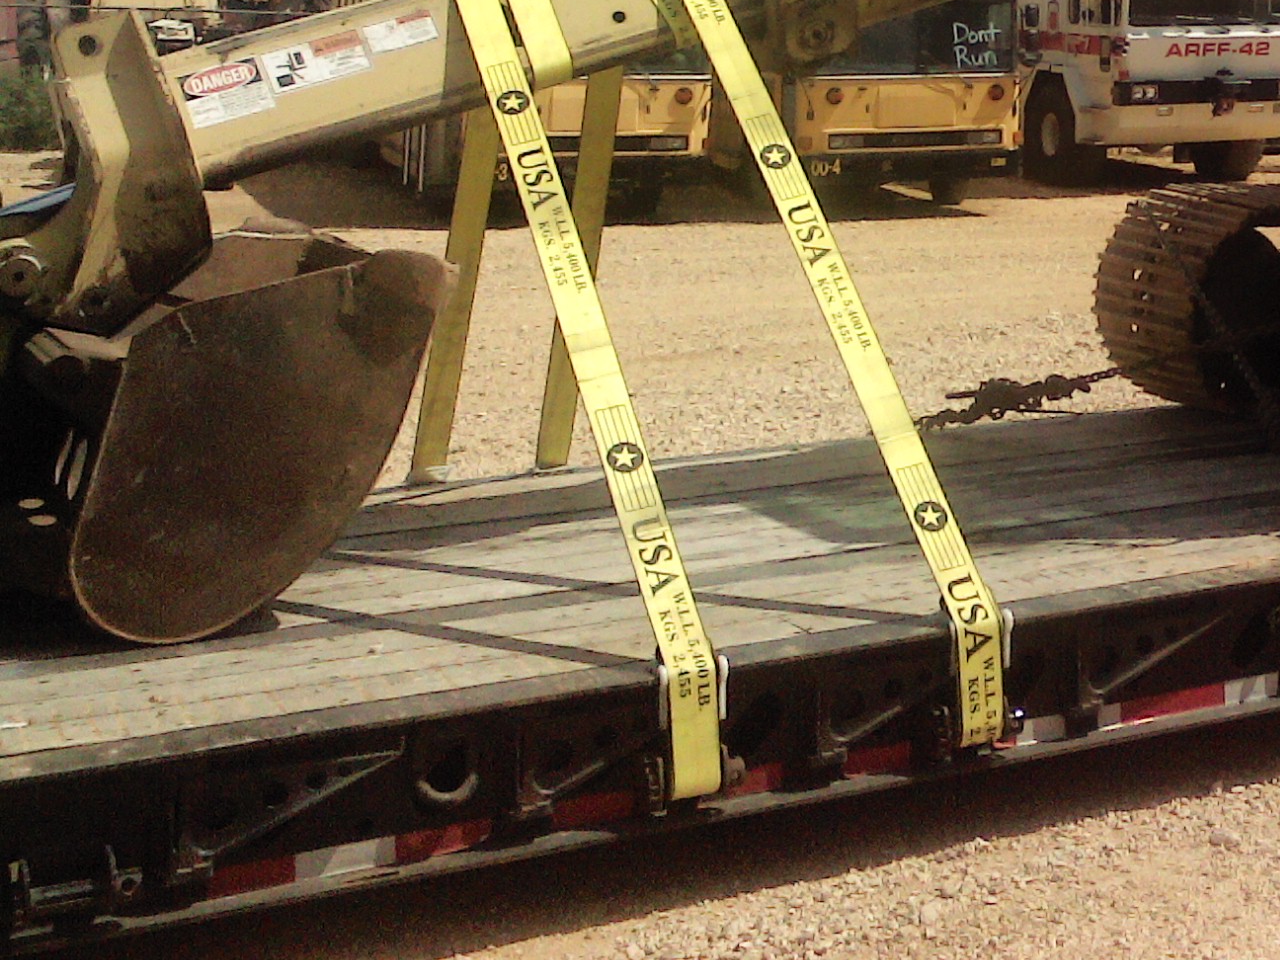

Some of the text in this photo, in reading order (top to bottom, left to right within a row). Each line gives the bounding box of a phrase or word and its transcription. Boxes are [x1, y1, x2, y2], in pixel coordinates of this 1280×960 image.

[953, 22, 1002, 44] Dont
[953, 45, 998, 69] Run
[1165, 41, 1270, 58] ARFF-42
[190, 64, 252, 94] DANGER
[517, 145, 559, 211] USA
[538, 221, 568, 286] KGS. 2,455
[788, 200, 832, 269] USA
[817, 277, 853, 344] KGS. 2,455
[843, 299, 864, 331] 5,400
[632, 513, 680, 599] USA
[947, 572, 993, 663] USA
[658, 609, 692, 698] KGS. 2,455
[672, 592, 711, 711] W.L.L. 5,400 LB.
[967, 676, 981, 720] KGS.
